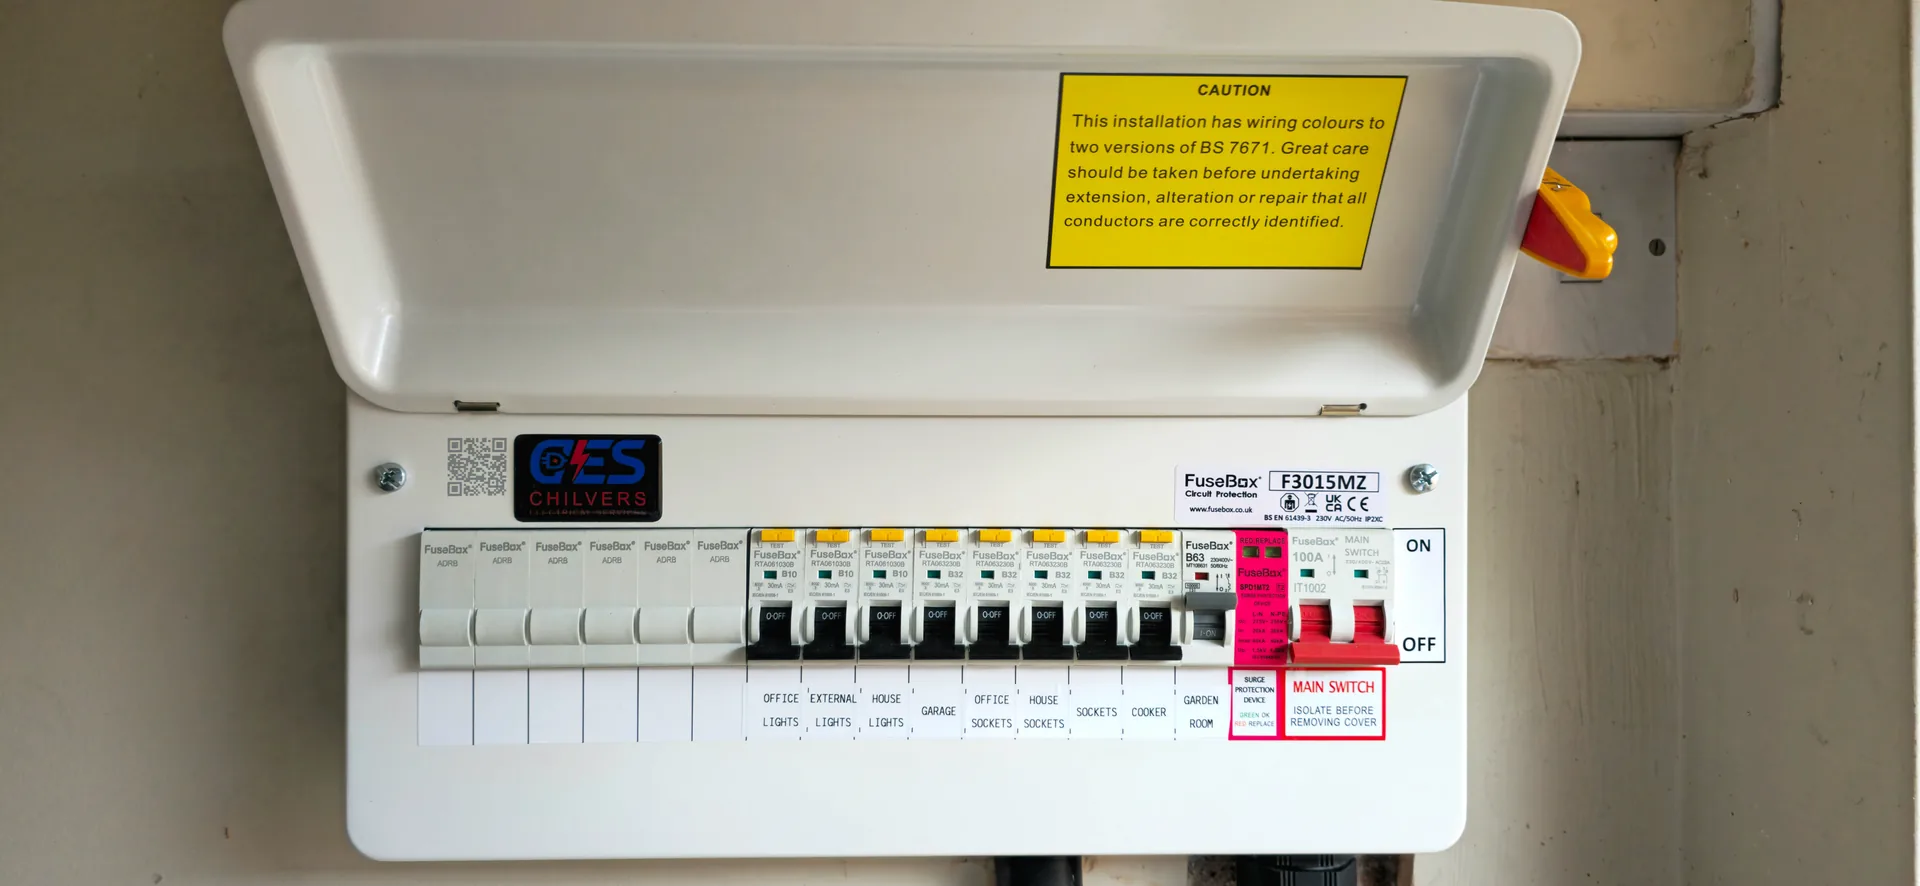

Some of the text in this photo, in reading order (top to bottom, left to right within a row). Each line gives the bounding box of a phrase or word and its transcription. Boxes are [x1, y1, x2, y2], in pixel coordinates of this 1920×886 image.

[1198, 84, 1271, 97] CAUTION
[1072, 114, 1385, 132] This installation has wiring colours to
[1070, 141, 1369, 155] two versions of BS 7671. Great care
[1068, 166, 1360, 182] should be taken before undertaking
[1066, 191, 1367, 206] extension, alteration or repair that all
[1064, 215, 1344, 230] conductors are correctly identified.
[1282, 475, 1366, 489] F3015MZ
[530, 491, 646, 506] CHILVERS
[1326, 495, 1341, 503] UK
[1326, 504, 1342, 512] CA
[1348, 497, 1369, 512] CE
[1407, 539, 1431, 552] ON
[656, 556, 676, 564] ADRB
[1186, 553, 1204, 561] B63
[1293, 552, 1323, 562] 100A
[1294, 583, 1326, 593] IT1002
[1403, 637, 1436, 651] OFF
[1293, 681, 1374, 693] MAIN SWITCH
[764, 694, 799, 703] OFFICE
[810, 694, 857, 703] EXTERNAL
[872, 694, 901, 703] HOUSE
[974, 695, 1009, 705] OFFICE
[1029, 695, 1058, 705] HOUSE
[1184, 696, 1219, 705] GARDEN
[921, 707, 956, 716] GARAGE
[1076, 707, 1117, 717] SOCKETS
[1132, 707, 1166, 717] COOKER
[1294, 706, 1373, 715] ISOLATE BEFORE
[763, 718, 799, 727] LIGHTS
[816, 718, 851, 727] LIGHTS
[869, 718, 904, 727] LIGHTS
[971, 719, 1012, 728] SOCKETS
[1024, 719, 1065, 728] SOCKETS
[1189, 719, 1214, 728] ROOM
[1291, 718, 1376, 727] REMOVING COVER
